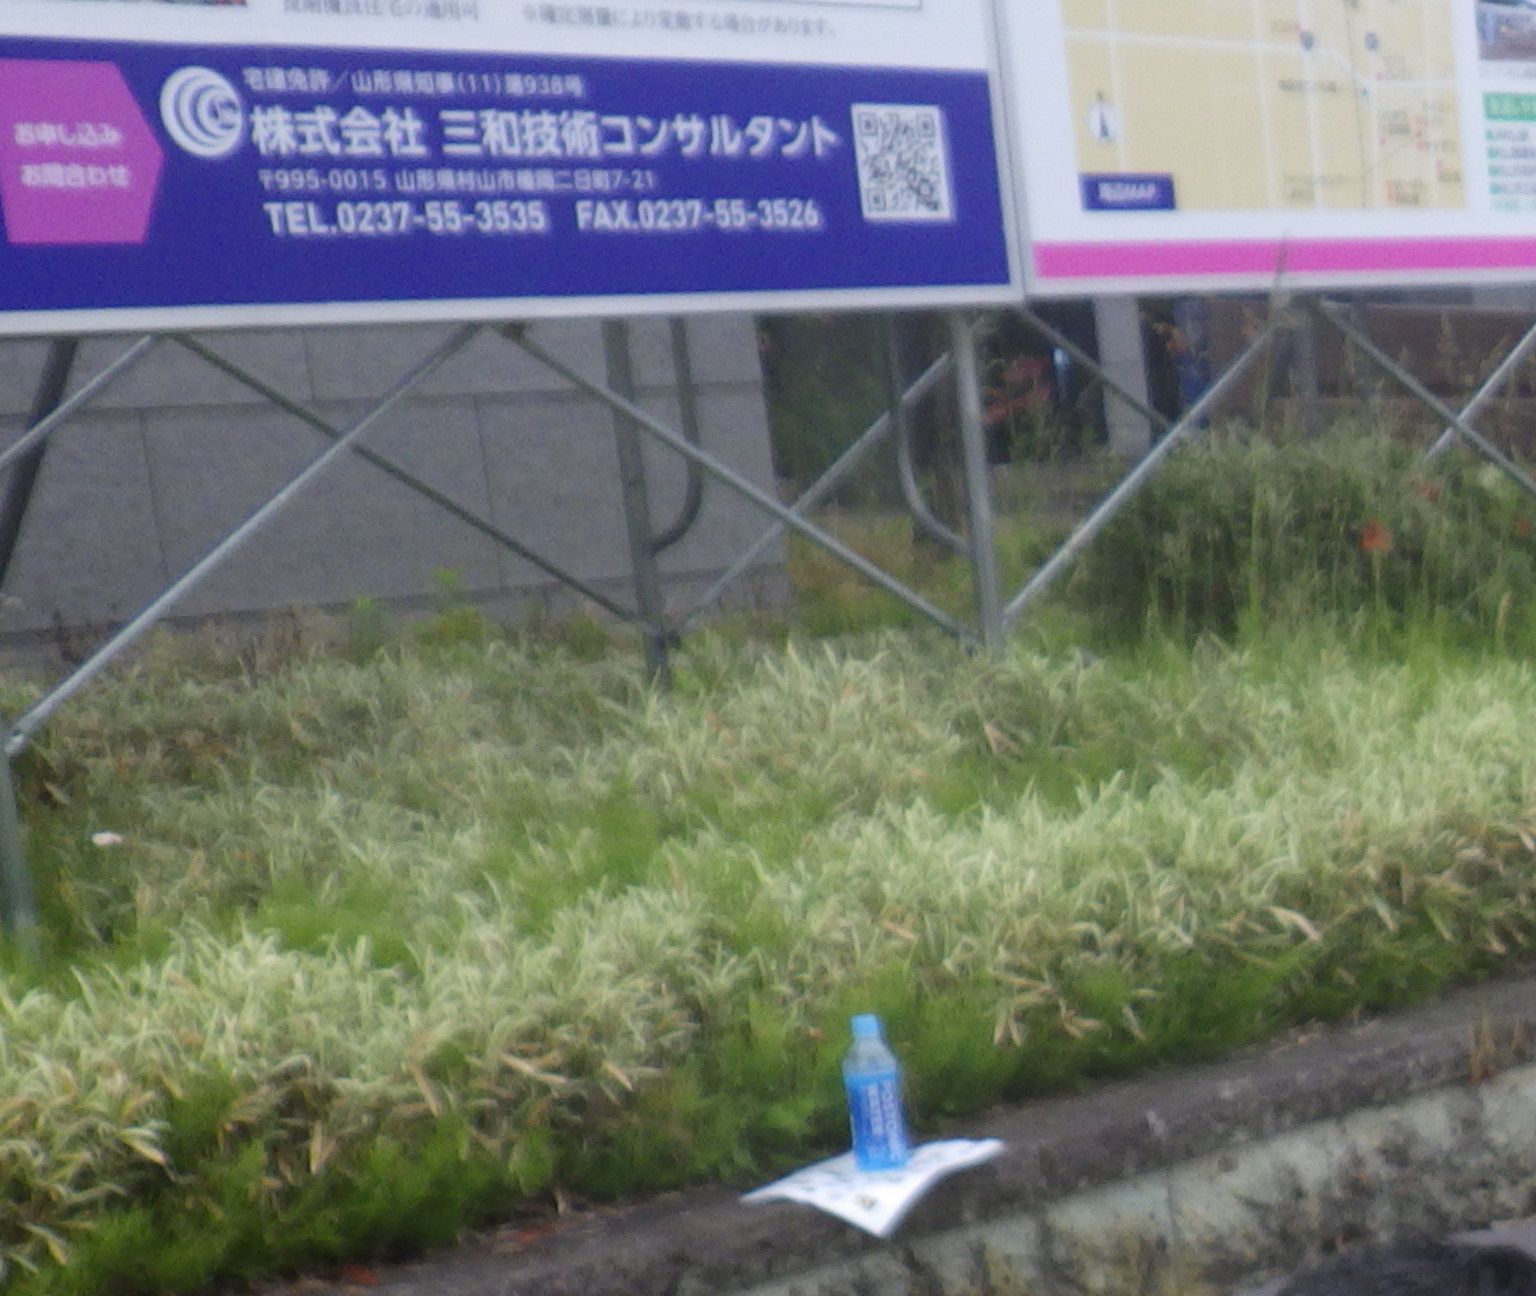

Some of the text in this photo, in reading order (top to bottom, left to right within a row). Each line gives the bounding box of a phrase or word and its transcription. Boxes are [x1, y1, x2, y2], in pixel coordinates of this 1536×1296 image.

[250, 104, 838, 157] 株式会社 三和技術コンサルタント
[263, 199, 820, 235] TEL.0237-55-3535 FAX.0237-55-3526
